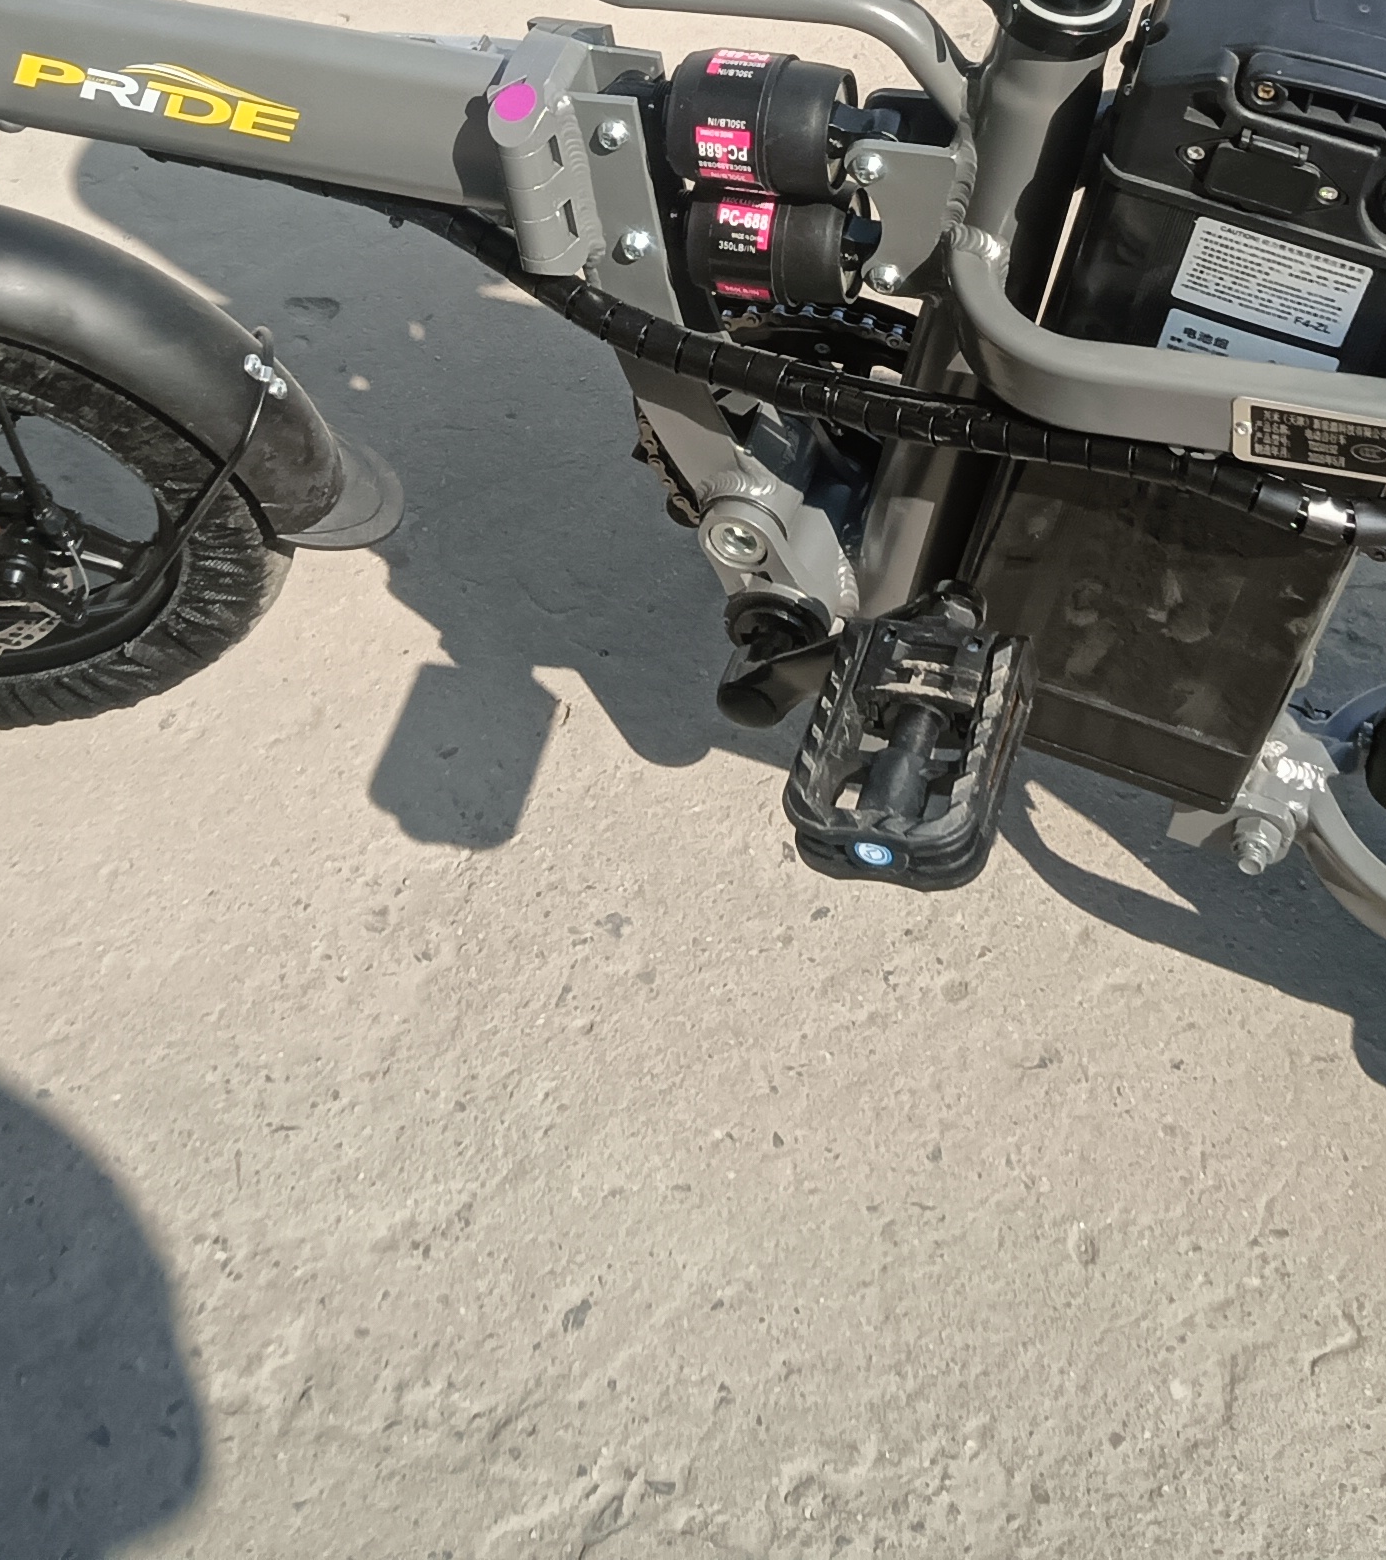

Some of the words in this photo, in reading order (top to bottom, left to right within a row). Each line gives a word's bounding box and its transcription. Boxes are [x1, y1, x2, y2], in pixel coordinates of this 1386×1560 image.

[12, 53, 301, 143] PRIDE
[707, 117, 747, 130] 350LB/IN
[698, 141, 748, 161] PC-688
[719, 208, 769, 230] PC-688
[718, 240, 756, 254] 350LB/IN
